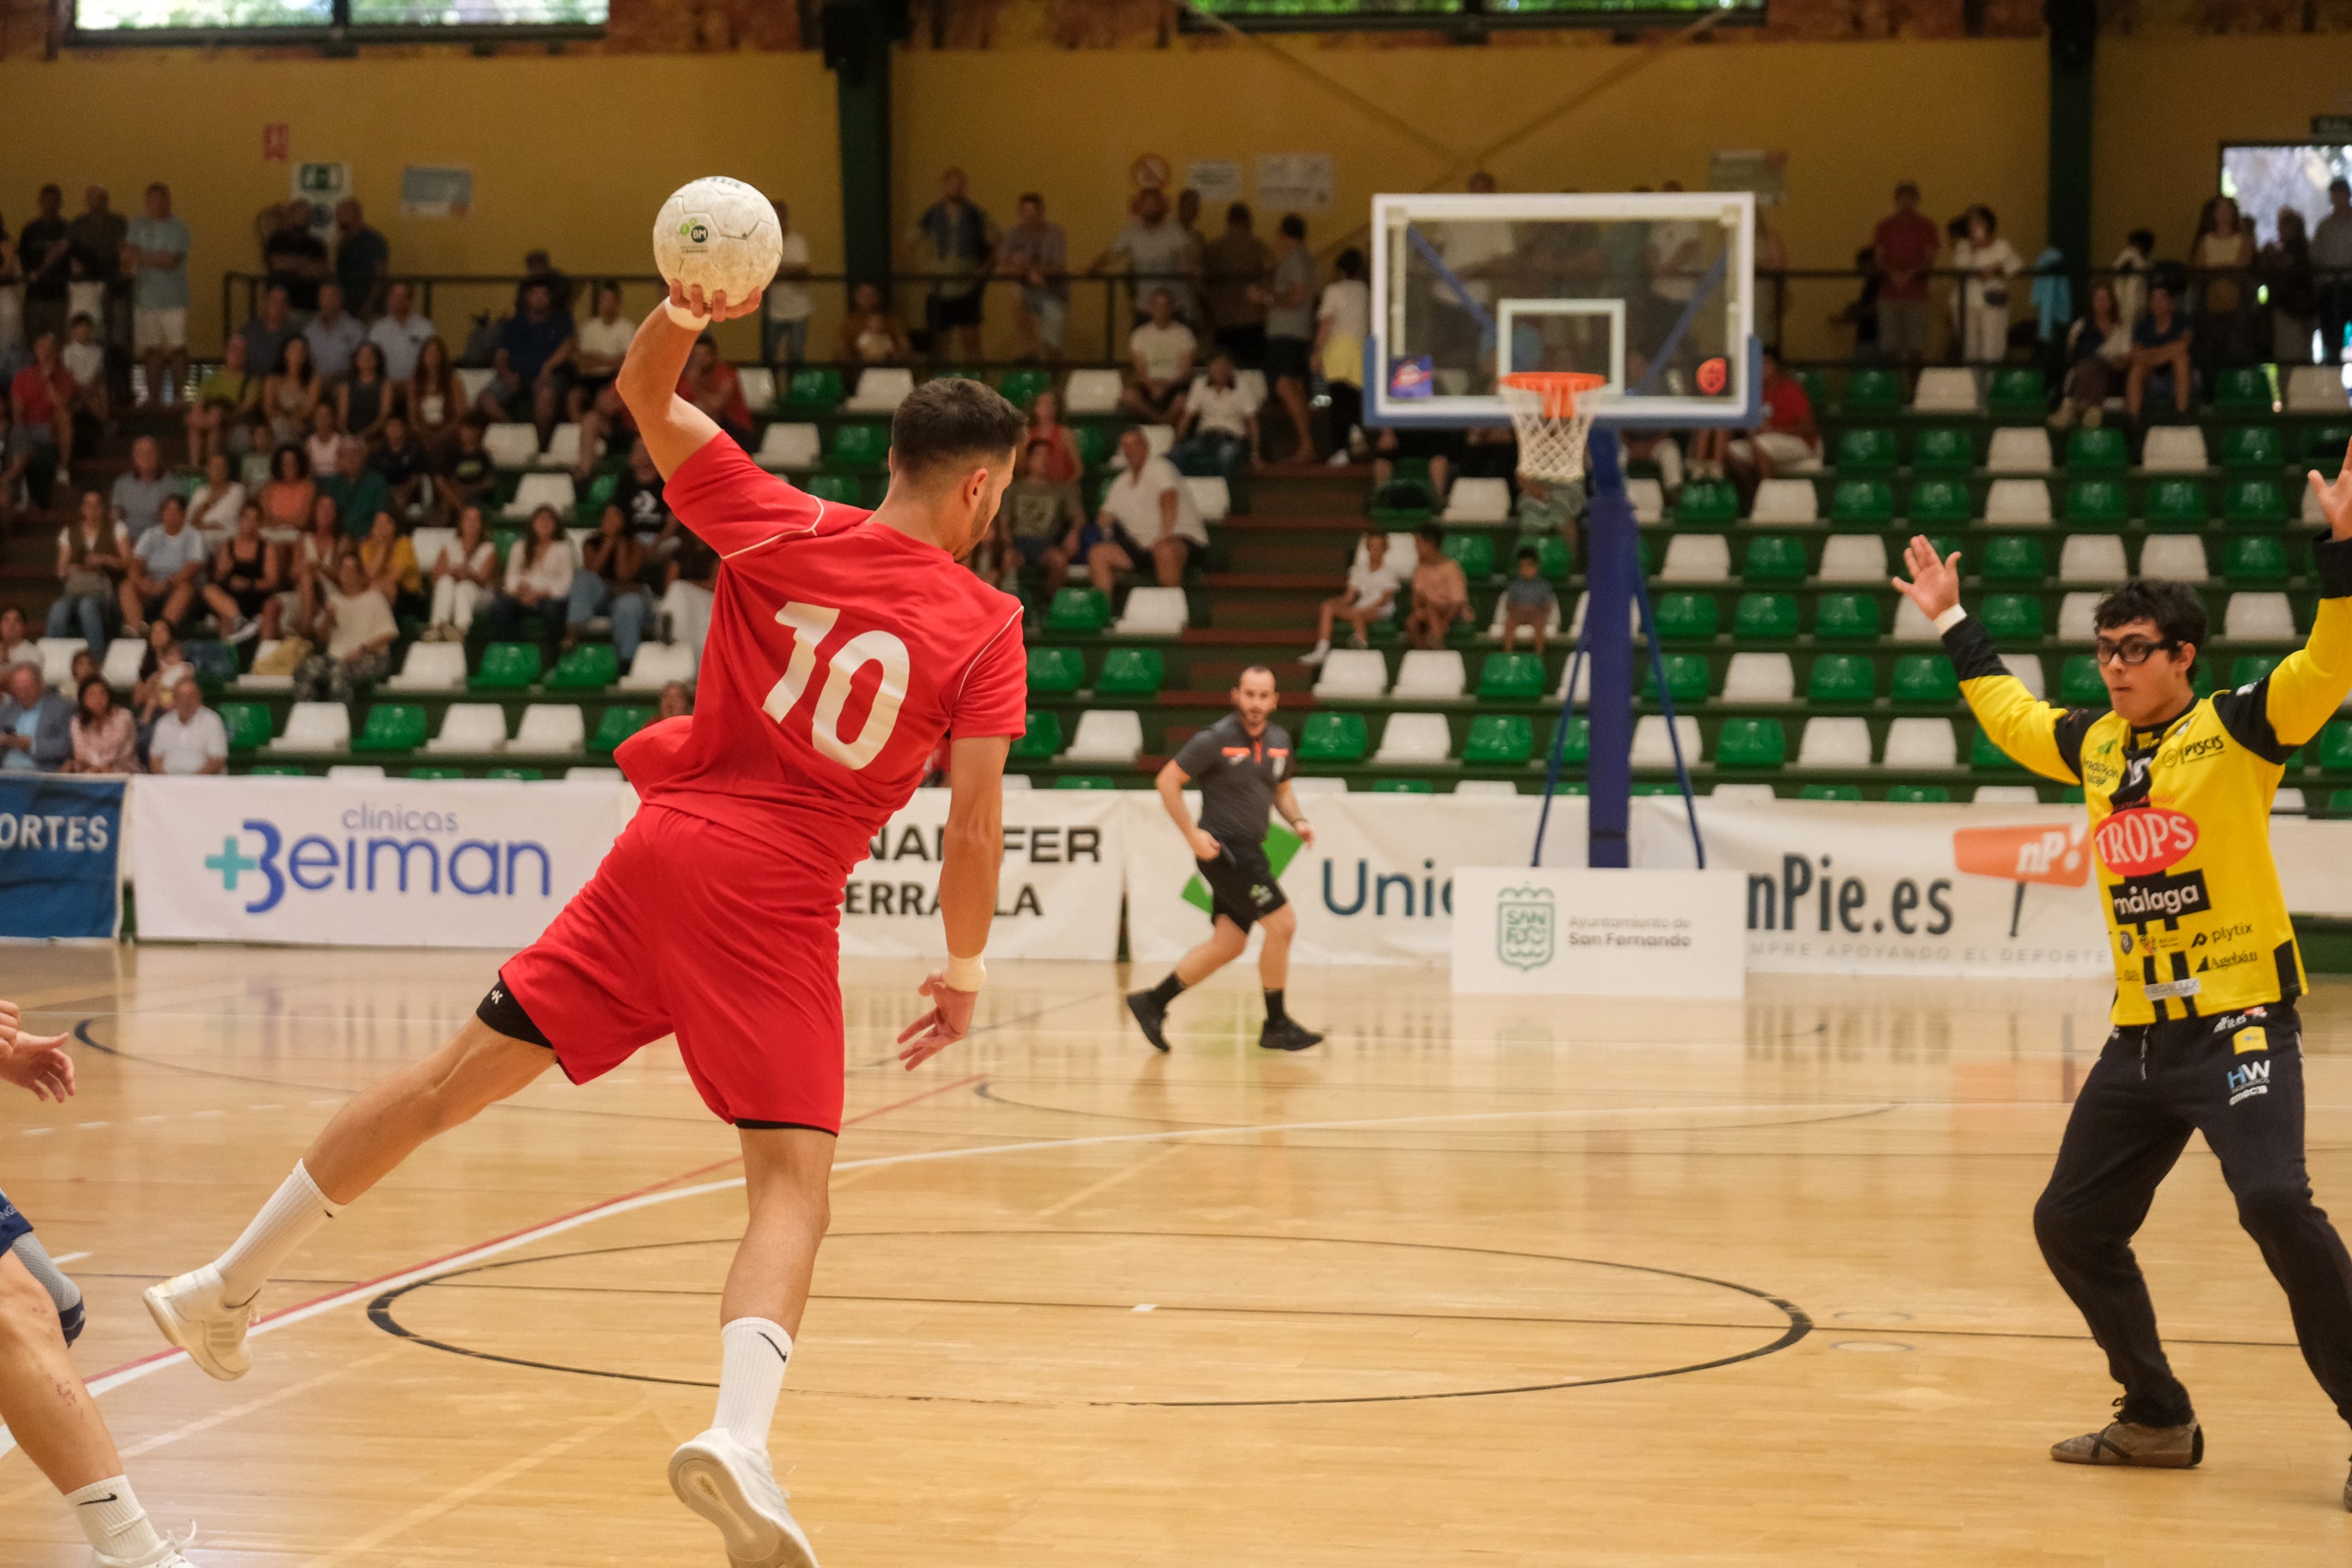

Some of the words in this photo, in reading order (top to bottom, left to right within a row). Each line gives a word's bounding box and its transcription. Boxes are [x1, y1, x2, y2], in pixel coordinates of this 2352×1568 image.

[693, 229, 707, 239] BM
[762, 601, 910, 770] 10
[0, 812, 109, 852] ORTES
[2096, 813, 2194, 864] TROPS
[242, 819, 551, 913] Beiman
[1673, 916, 1692, 928] de
[2211, 923, 2253, 943] plytix
[1569, 932, 1602, 946] San
[1606, 931, 1692, 947] Fernando
[1964, 948, 1991, 962] EL
[2001, 948, 2108, 963] DEPORTE
[2227, 1059, 2271, 1089] HW
